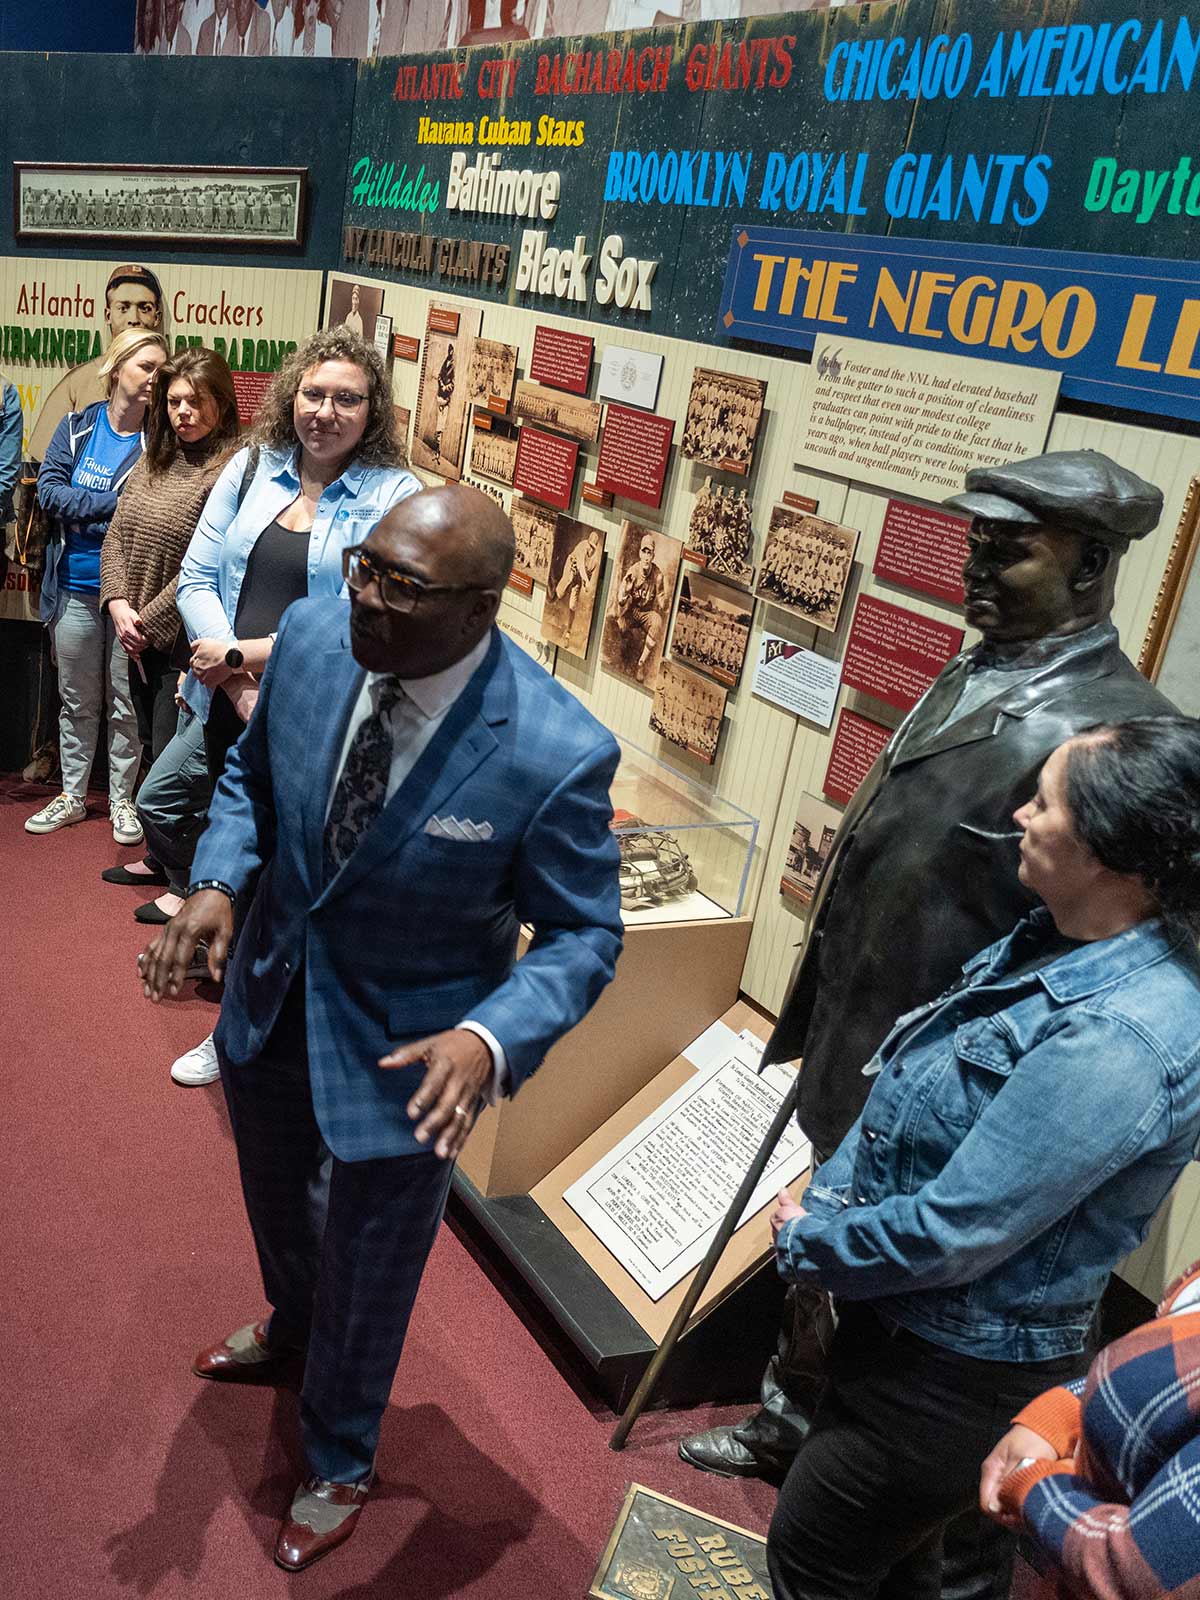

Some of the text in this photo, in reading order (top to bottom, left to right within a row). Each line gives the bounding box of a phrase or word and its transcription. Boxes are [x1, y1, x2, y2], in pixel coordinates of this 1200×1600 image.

[394, 36, 797, 100] ATLANTIC CITY BACHARACH GIANTS
[825, 16, 1200, 102] CHICAGO AMERICAN
[417, 114, 585, 147] Havana Cuban Stars
[351, 156, 440, 213] Hilldales
[446, 152, 561, 218] Baltimore
[604, 150, 1052, 226] BROOKLYN ROYAL GIANTS
[367, 228, 435, 272] LINCOLN
[437, 237, 511, 283] GIANTS
[516, 229, 658, 311] Black Sox
[17, 282, 264, 327] Atlanta Crackers
[752, 253, 859, 323] THE
[868, 267, 1096, 358] NEGRO
[815, 386, 992, 432] and respect that even our modest college
[841, 374, 856, 387] the
[855, 380, 884, 392] gutter
[883, 384, 894, 394] to
[895, 387, 917, 399] such
[917, 392, 925, 401] a
[924, 393, 965, 409] position
[965, 399, 979, 413] of
[978, 401, 1035, 423] cleanliness
[843, 359, 871, 375] Foster
[871, 367, 891, 379] and
[890, 368, 906, 382] the
[909, 371, 930, 386] NNL
[931, 375, 951, 390] had
[951, 380, 993, 398] elevated
[992, 386, 1039, 406] baseball
[807, 428, 829, 441] years
[848, 436, 871, 451] when
[871, 440, 890, 456] ball
[888, 446, 923, 464] players
[924, 456, 948, 470] were
[947, 459, 970, 475] look
[809, 411, 818, 423] is
[817, 416, 824, 425] a
[824, 415, 867, 436] ballplayer,
[868, 425, 902, 443] instead
[901, 433, 914, 447] of
[912, 438, 924, 448] as
[924, 441, 975, 460] conditions
[976, 453, 1001, 469] were
[812, 400, 1028, 456] graduates can point with pride to the fact that he
[83, 456, 114, 477] THINK
[803, 441, 959, 489] uncouth and ungentlemanly persons.
[694, 1532, 769, 1600] RUBE
